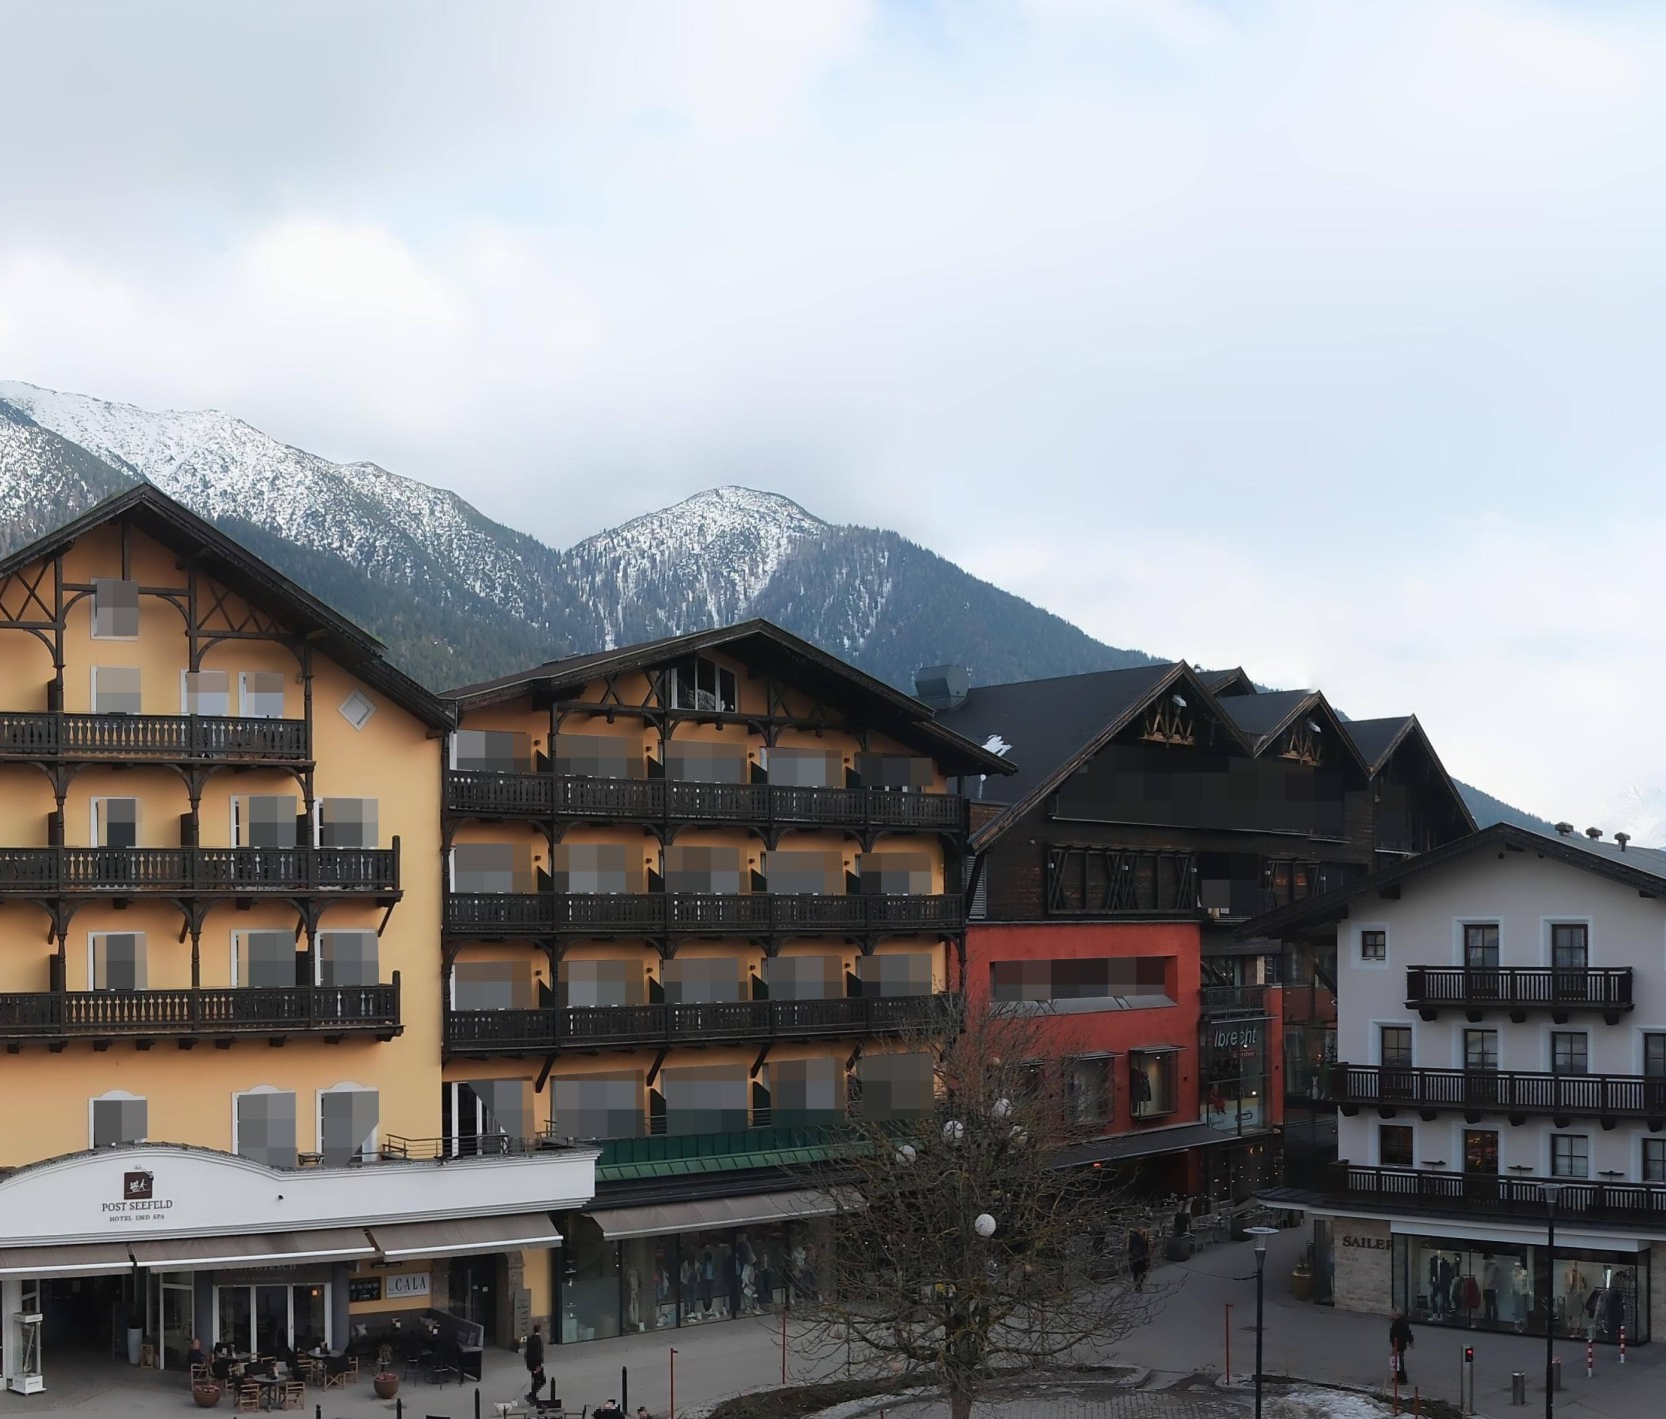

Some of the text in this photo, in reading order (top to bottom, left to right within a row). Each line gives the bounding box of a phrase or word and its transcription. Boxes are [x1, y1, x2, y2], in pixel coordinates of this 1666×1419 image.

[102, 1200, 173, 1212] POST SEEFELD
[395, 1276, 426, 1291] CALA
